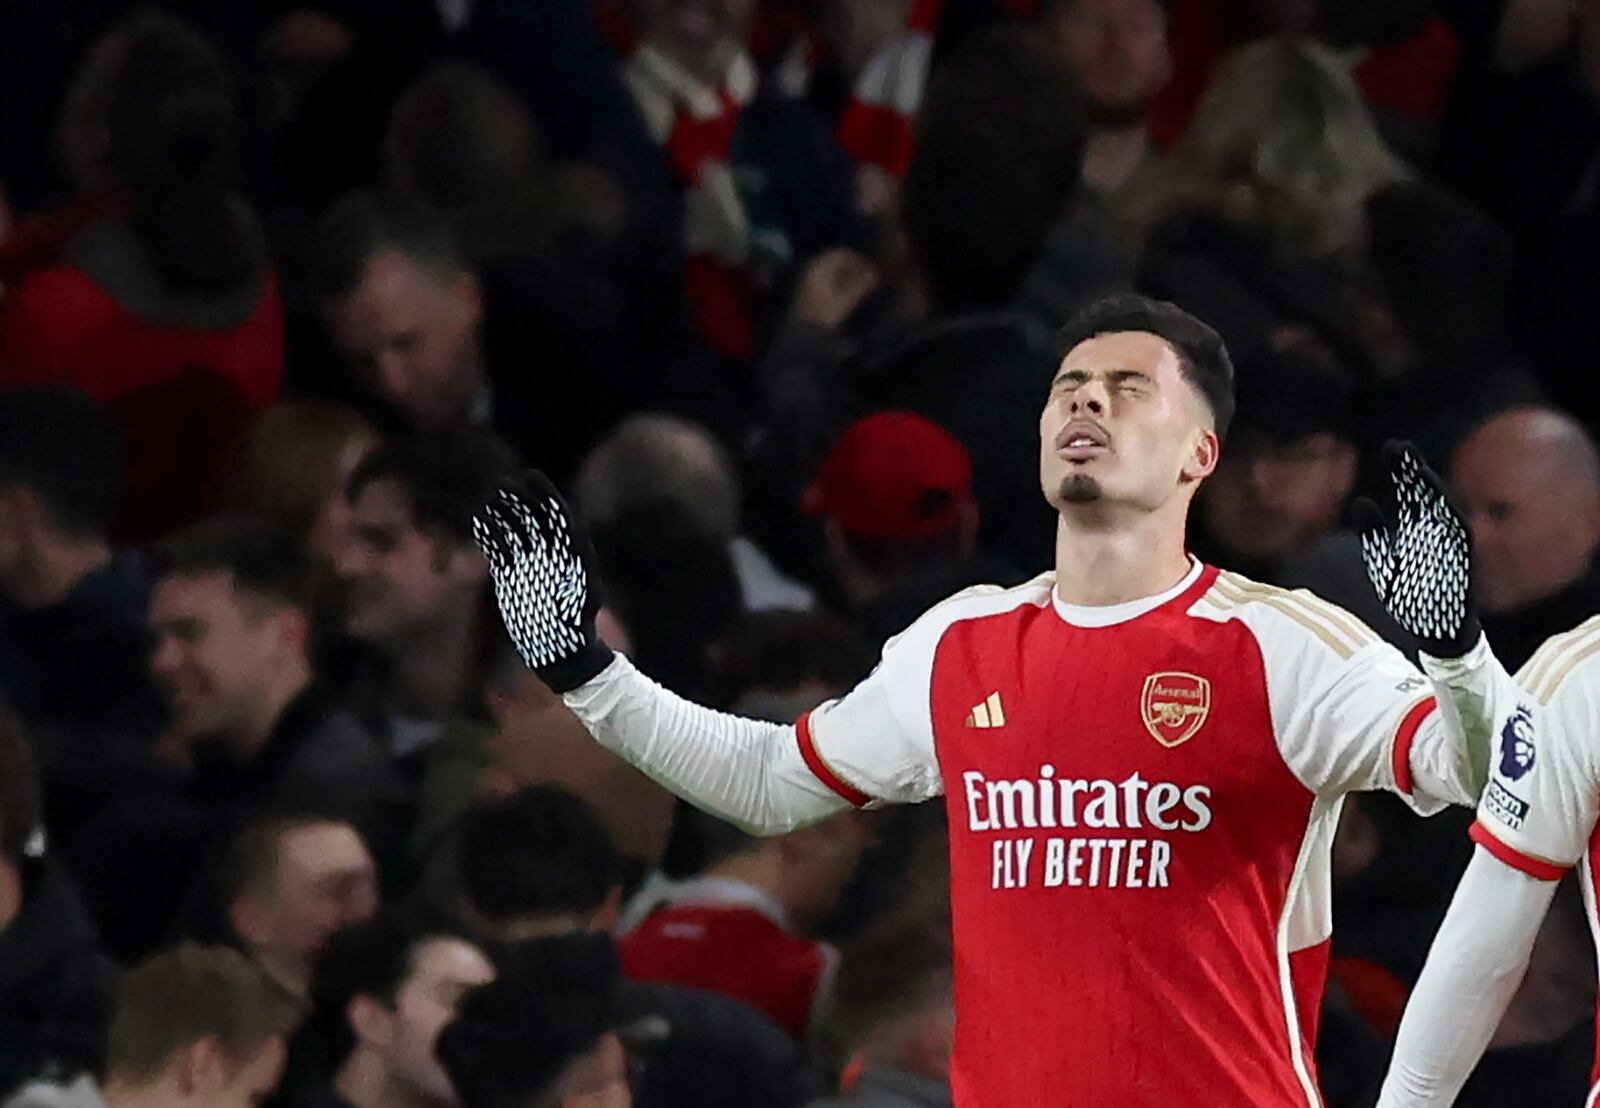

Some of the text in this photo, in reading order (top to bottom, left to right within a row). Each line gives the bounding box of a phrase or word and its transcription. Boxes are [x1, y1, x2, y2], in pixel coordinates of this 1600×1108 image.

[963, 764, 1212, 833] Emirates
[992, 838, 1171, 889] FLY BETTER
